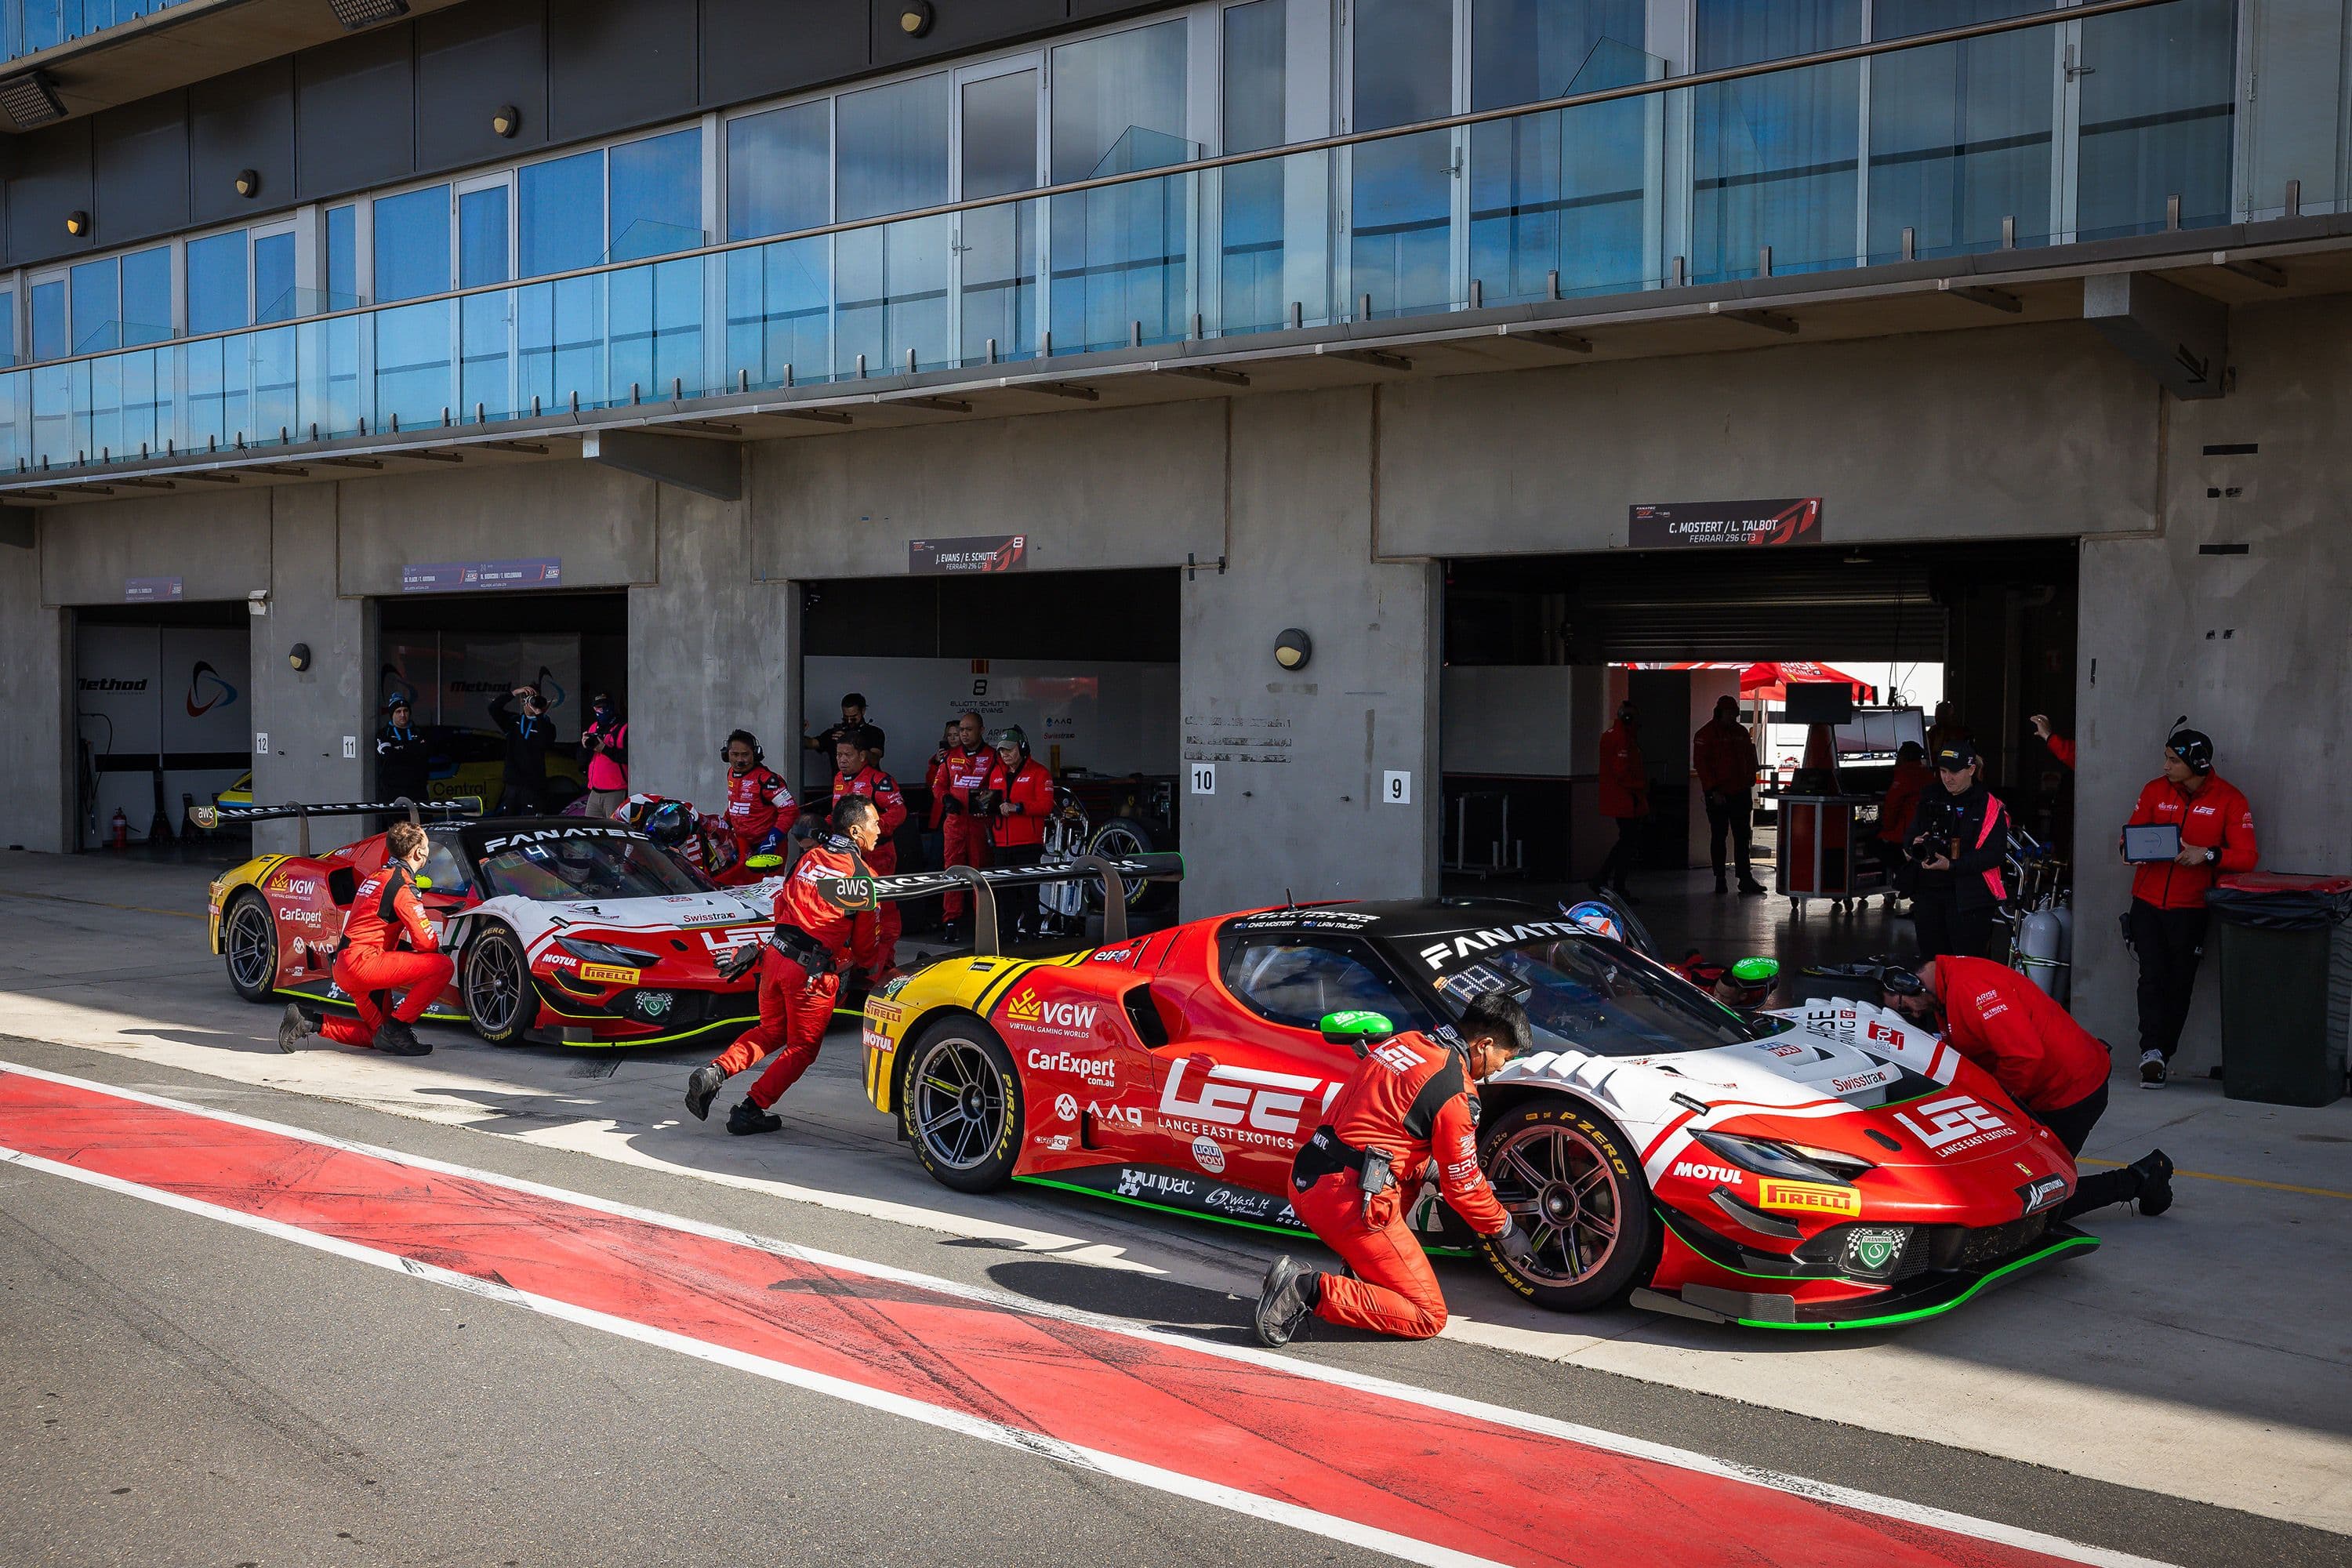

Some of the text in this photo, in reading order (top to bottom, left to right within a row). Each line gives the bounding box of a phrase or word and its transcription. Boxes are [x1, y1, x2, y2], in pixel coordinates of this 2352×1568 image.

[1810, 500, 1817, 514] 1
[1669, 520, 1778, 533] C. MOSTERT / L. TALBOT
[1013, 537, 1023, 548] 8
[1690, 533, 1755, 543] FERRARI 296 GT3
[941, 553, 960, 562] EVANS
[965, 553, 971, 561] E.
[971, 552, 997, 561] SCHUTTE
[973, 680, 987, 695] 8
[258, 738, 267, 750] 12
[345, 741, 354, 755] 11
[1194, 771, 1212, 790] 10
[1392, 779, 1402, 798] 9
[433, 782, 487, 796] Central
[198, 808, 213, 818] aws
[217, 806, 283, 818] ANCE
[485, 828, 649, 853] FANATEC
[524, 844, 549, 858] 4
[289, 879, 315, 895] VGW
[837, 878, 869, 896] aws
[279, 908, 321, 924] CarExpert
[683, 912, 731, 923] Swisstrax
[1420, 922, 1610, 971] FANATEC
[542, 953, 578, 967] MOTUL
[584, 966, 635, 981] PIRELLI
[1976, 990, 1998, 1003] ARISE
[866, 1000, 902, 1023] PIRELLI
[1043, 1001, 1096, 1029] VGW
[1009, 1022, 1090, 1039] VIRTUAL GAMING WORLDS
[864, 1030, 892, 1051] MOTUL
[1027, 1049, 1114, 1079] CarExpert
[1374, 1039, 1428, 1073] LEE
[1087, 1076, 1114, 1087] com.au
[1832, 1072, 1883, 1091] Swisstrax
[1158, 1058, 1323, 1134] LEE
[998, 1073, 1017, 1161] PIRELLI
[1893, 1095, 2006, 1149] LEE
[1158, 1116, 1294, 1150] LANCE EAST EXOTICS
[1195, 1144, 1220, 1156] LIQUI
[1560, 1112, 1626, 1174] P ZERO
[1936, 1127, 2017, 1157] LANCE EAST EXOTICS
[1197, 1154, 1222, 1166] MOLY
[1448, 1153, 1477, 1173] SRO
[1673, 1161, 1743, 1185] MOTUL
[1142, 1172, 1196, 1195] unipac
[1230, 1194, 1270, 1209] Wash It
[1767, 1185, 1851, 1210] PIRELLI
